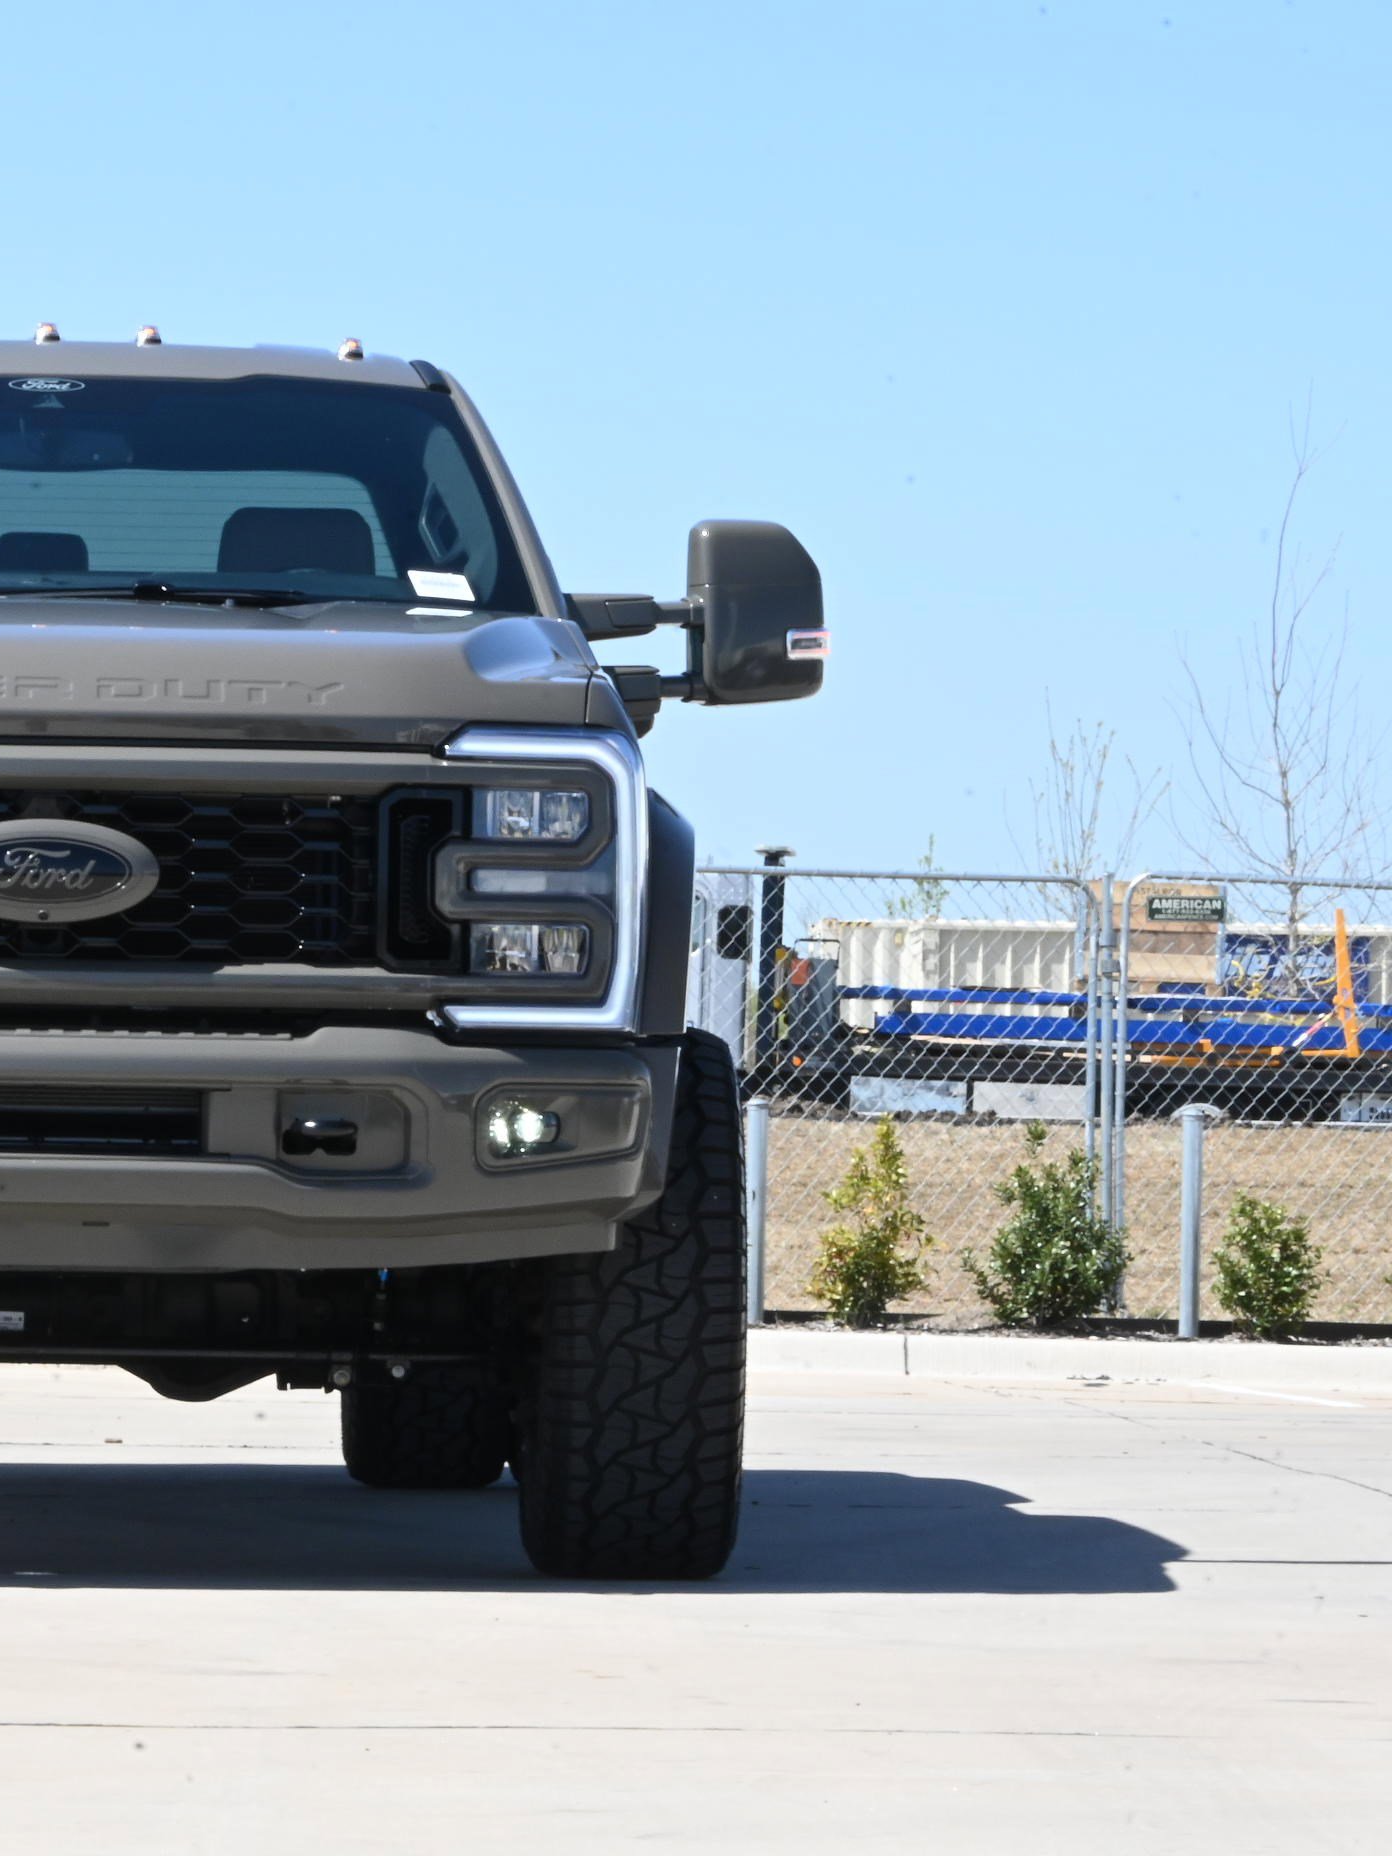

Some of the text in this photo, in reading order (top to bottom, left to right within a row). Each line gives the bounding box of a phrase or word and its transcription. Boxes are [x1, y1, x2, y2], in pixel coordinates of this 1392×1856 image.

[21, 380, 71, 391] Ford
[95, 677, 345, 705] DUTY
[1152, 899, 1222, 909] AMERICAN
